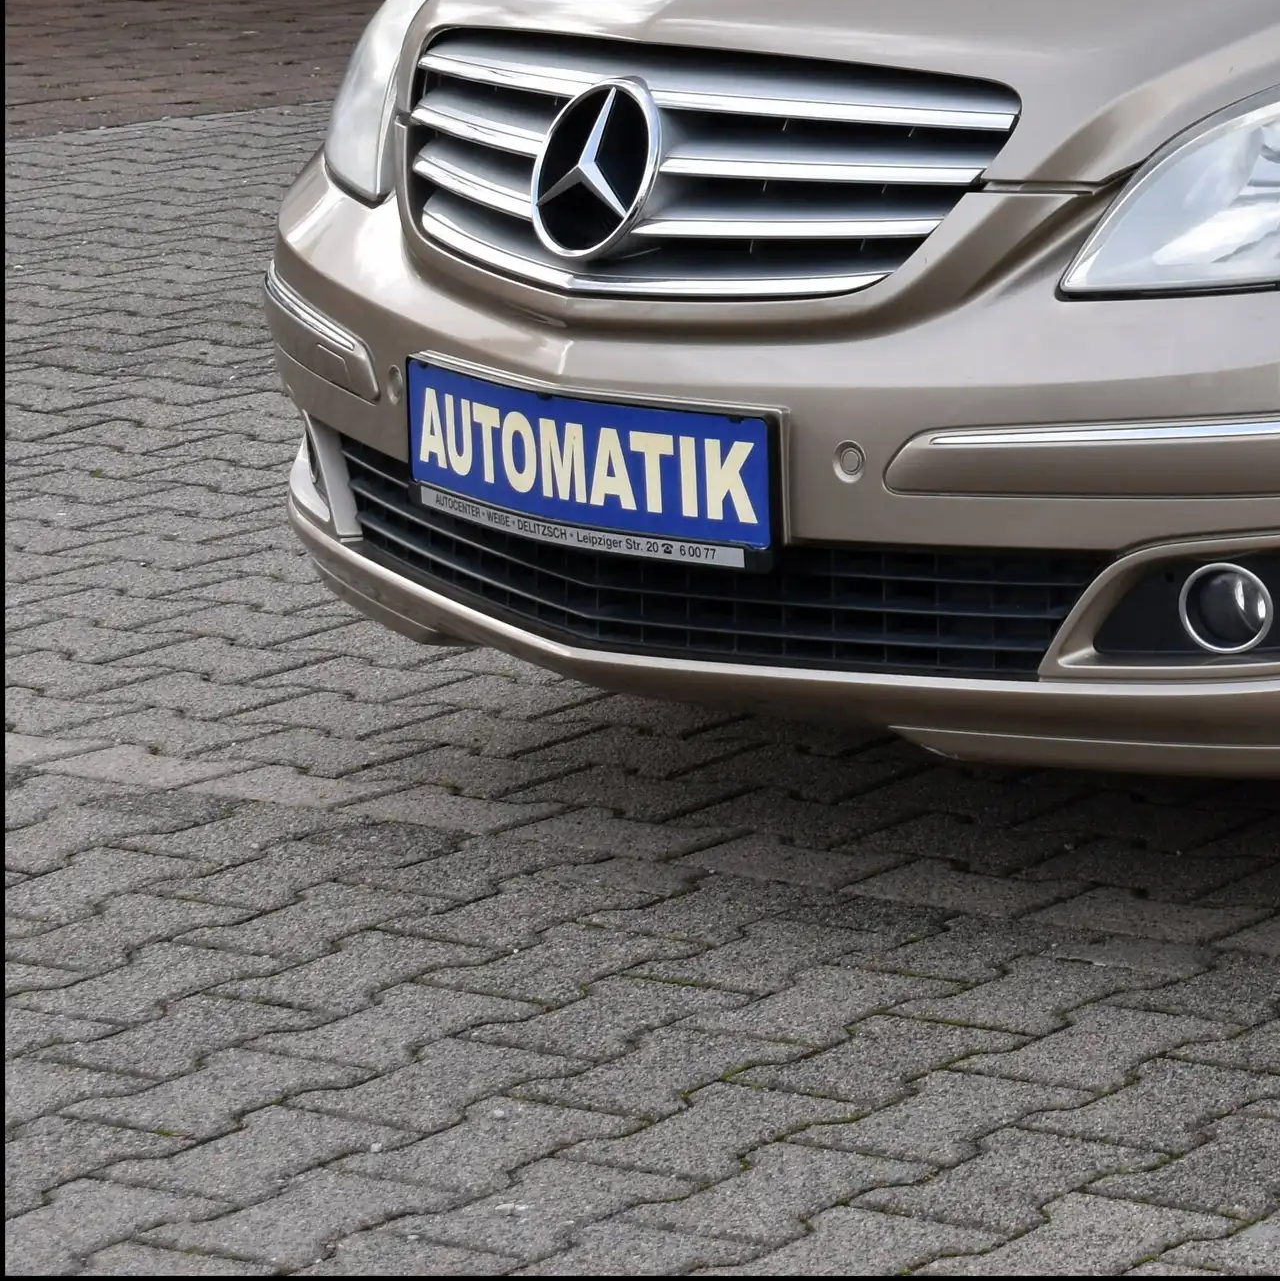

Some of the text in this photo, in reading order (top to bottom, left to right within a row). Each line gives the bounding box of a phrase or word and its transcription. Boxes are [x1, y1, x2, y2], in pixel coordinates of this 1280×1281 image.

[419, 387, 759, 524] AUTOMATIK
[435, 493, 481, 518] AUTOCENTER
[517, 521, 567, 540] DELITZSCH
[577, 531, 622, 549] Leipziger
[626, 538, 643, 551] Str.
[647, 541, 659, 553] 20
[680, 545, 686, 556] 6
[689, 546, 701, 558] 00
[704, 547, 716, 559] 77
